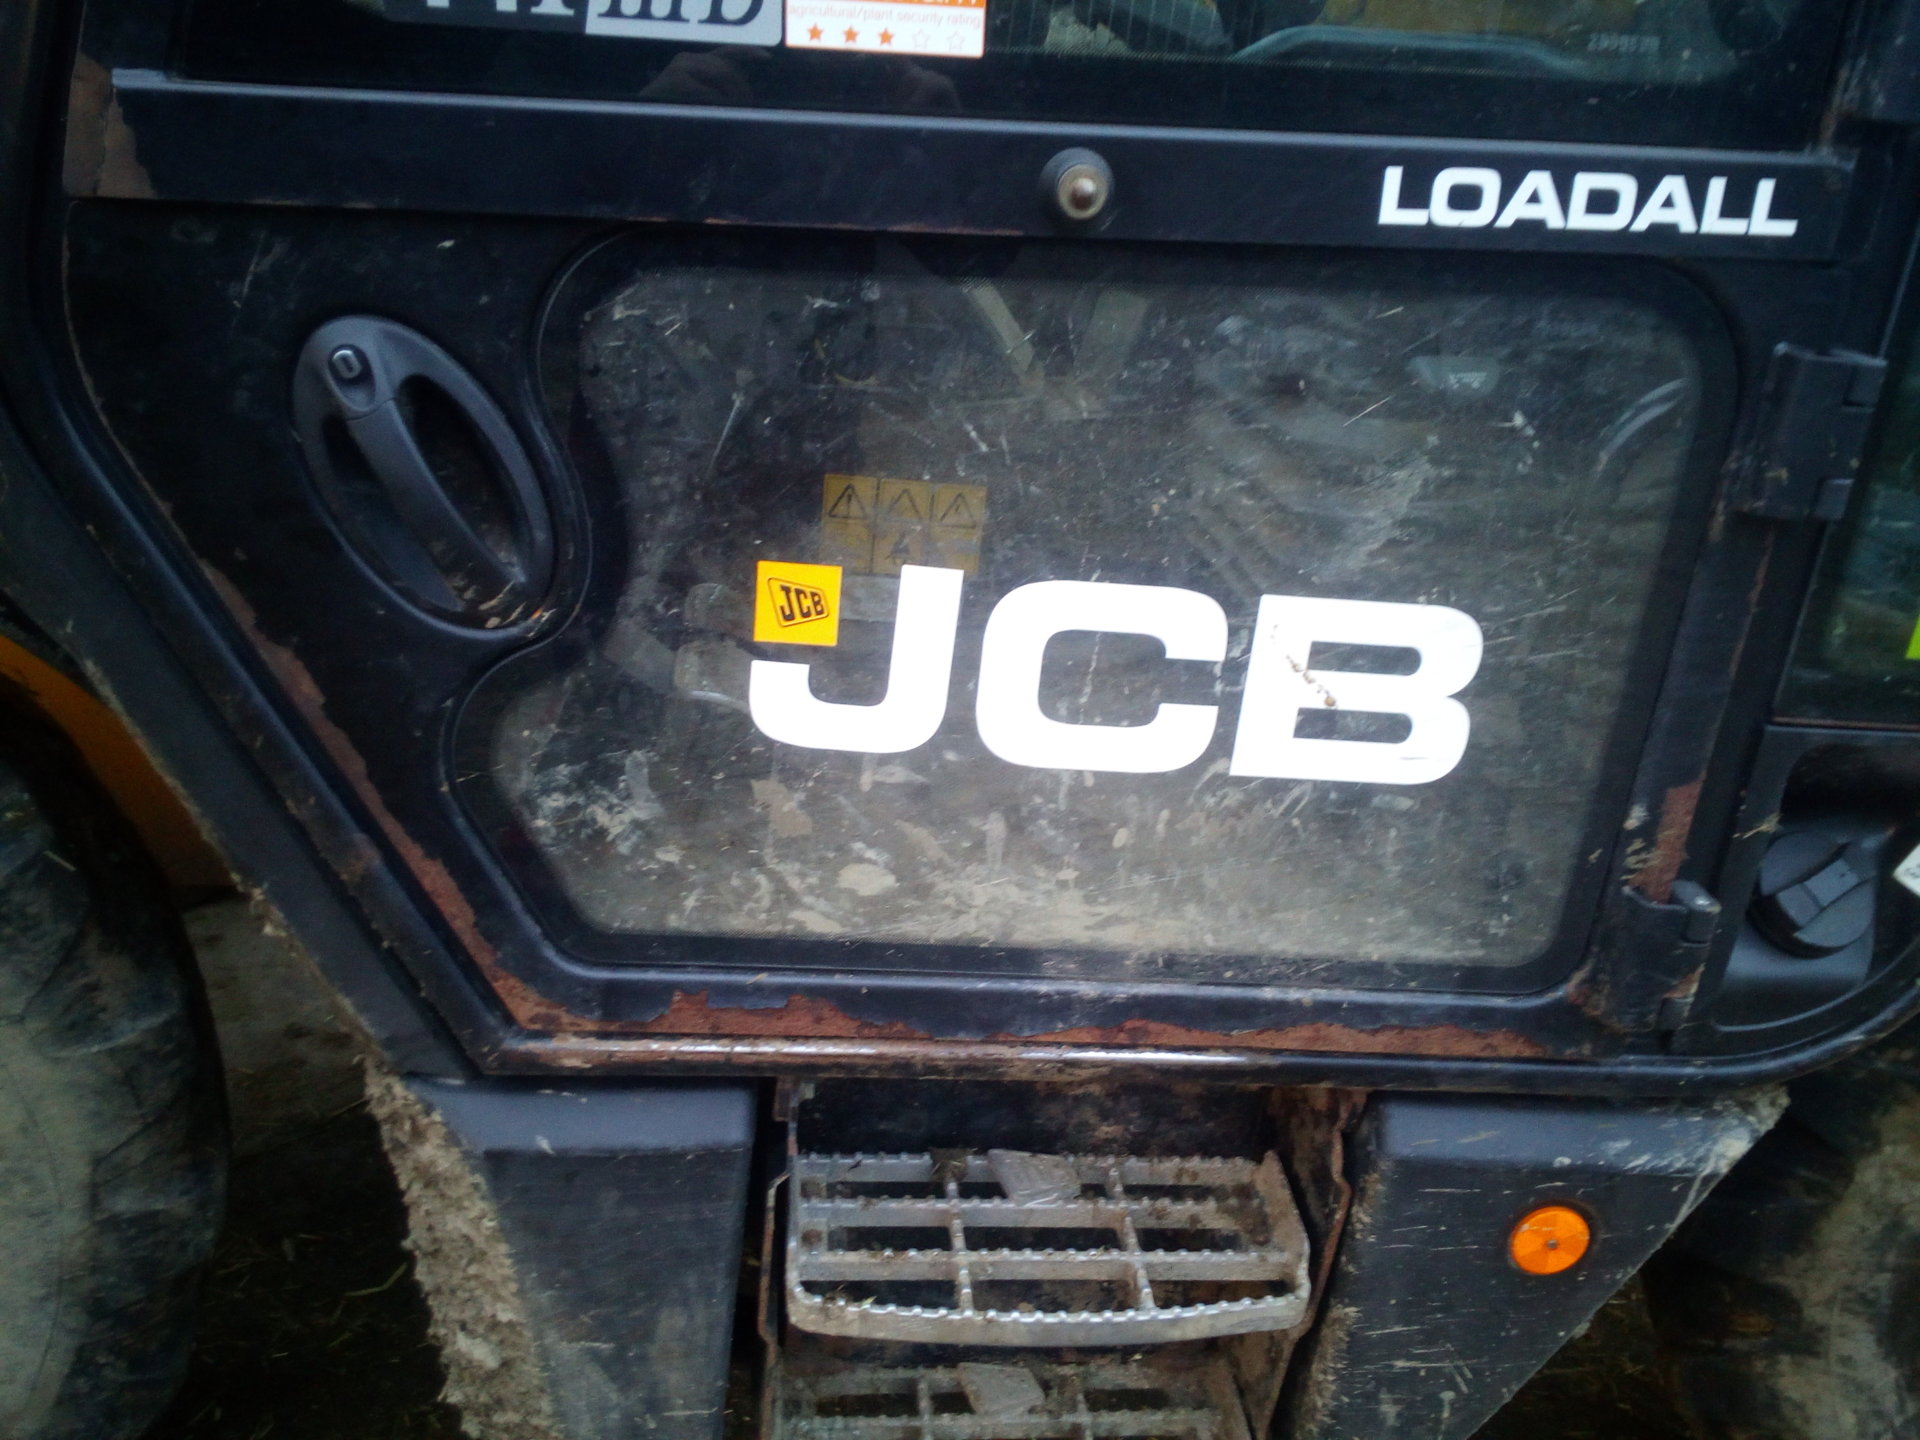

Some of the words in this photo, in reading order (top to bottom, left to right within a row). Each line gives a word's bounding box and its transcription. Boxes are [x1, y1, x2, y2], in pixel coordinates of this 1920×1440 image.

[897, 12, 944, 26] security
[947, 15, 981, 29] rating
[1378, 165, 1798, 237] LOADALL
[779, 584, 825, 621] JCB
[749, 564, 1484, 785] JCB
